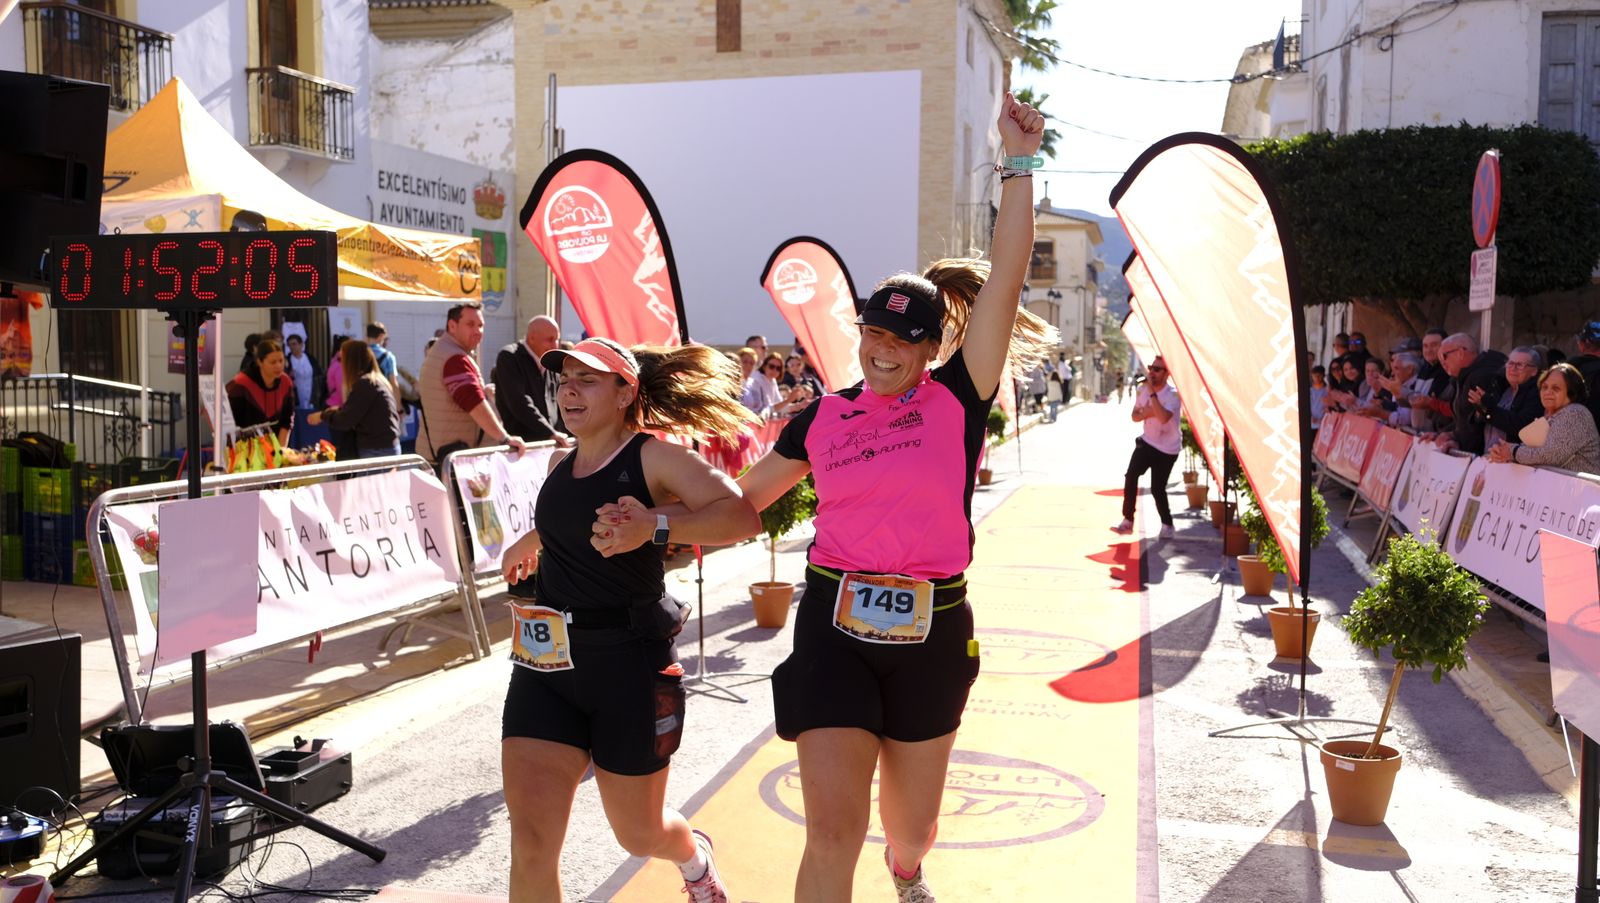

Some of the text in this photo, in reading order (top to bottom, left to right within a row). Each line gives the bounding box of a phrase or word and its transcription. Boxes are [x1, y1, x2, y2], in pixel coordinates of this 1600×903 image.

[378, 170, 466, 205] EXCELENTÍSIMO
[380, 203, 465, 233] AYUNTAMIENTO
[60, 238, 319, 301] 01:52:05
[888, 416, 923, 430] TRAINING
[264, 502, 427, 549] NTAMIENTO DE
[1490, 490, 1595, 540] AYUNTAMIENTO DE
[1477, 512, 1541, 563] CANTO
[258, 527, 441, 603] ANTORIA
[857, 587, 914, 614] 149
[523, 622, 551, 643] 18
[947, 770, 1061, 787] LA PO
[185, 804, 200, 843] VONYX
